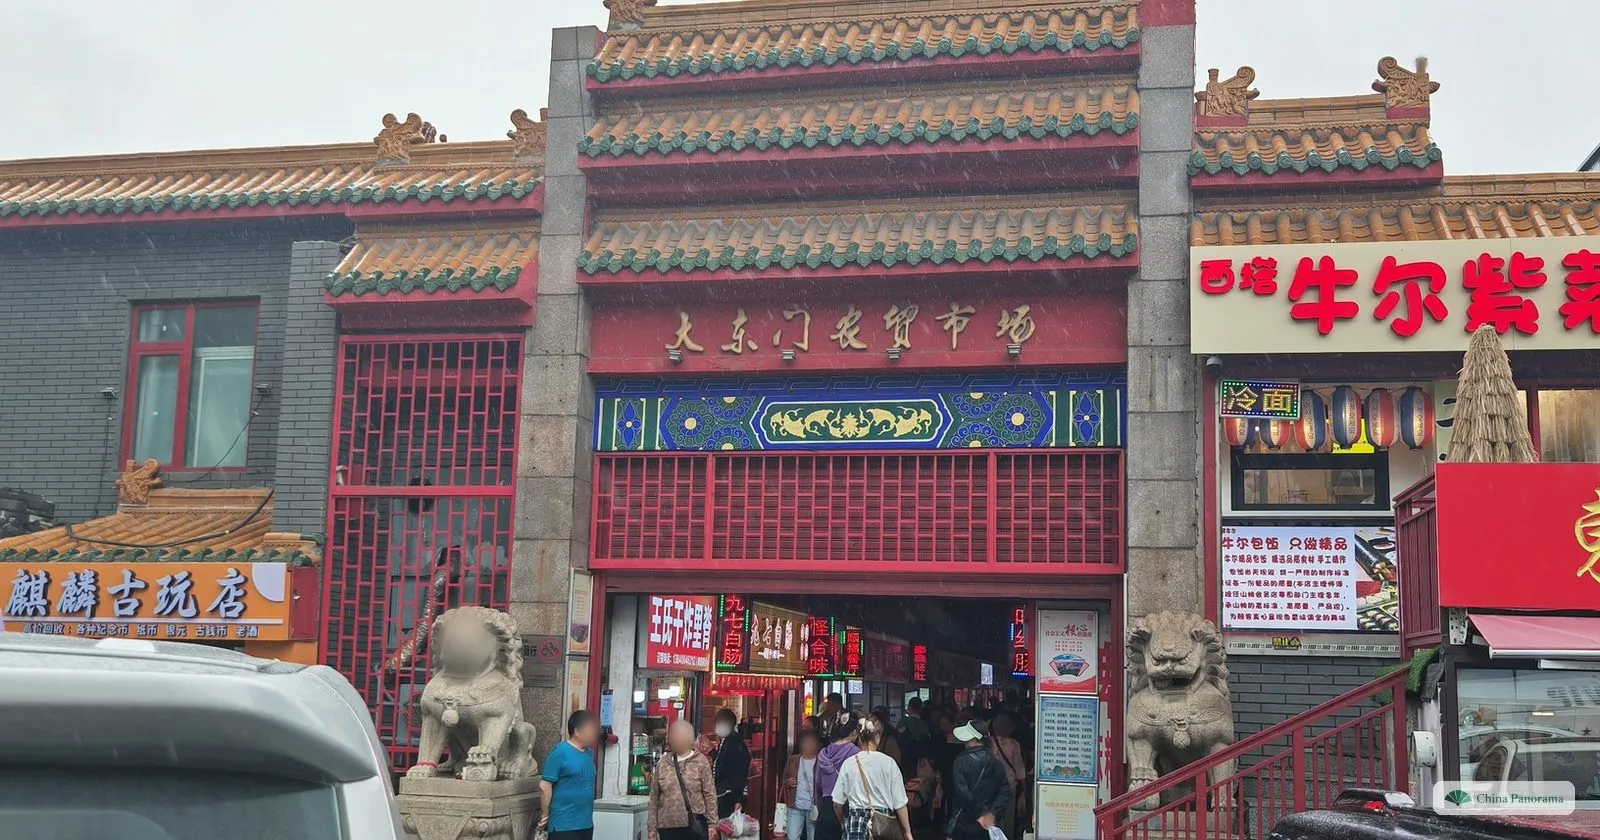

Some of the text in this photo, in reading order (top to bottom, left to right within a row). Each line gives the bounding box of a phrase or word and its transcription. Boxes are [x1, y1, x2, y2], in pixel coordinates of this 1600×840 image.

[1200, 256, 1278, 295] 西塔
[665, 303, 1036, 352] 大东门农贸市场
[1227, 387, 1294, 412] 冷面
[1222, 537, 1348, 550] 牛尔包饭 只做精品
[5, 568, 248, 618] 麒麟古玩店
[76, 623, 129, 636] 各种纪念币
[136, 624, 157, 636] 纸币
[165, 624, 188, 636] 银元
[195, 625, 228, 637] 古钱币
[236, 625, 259, 638] 老酒
[650, 596, 712, 651] 王氏干炸里脊
[723, 595, 744, 665] 九七白肠
[809, 619, 829, 673] 怪合味
